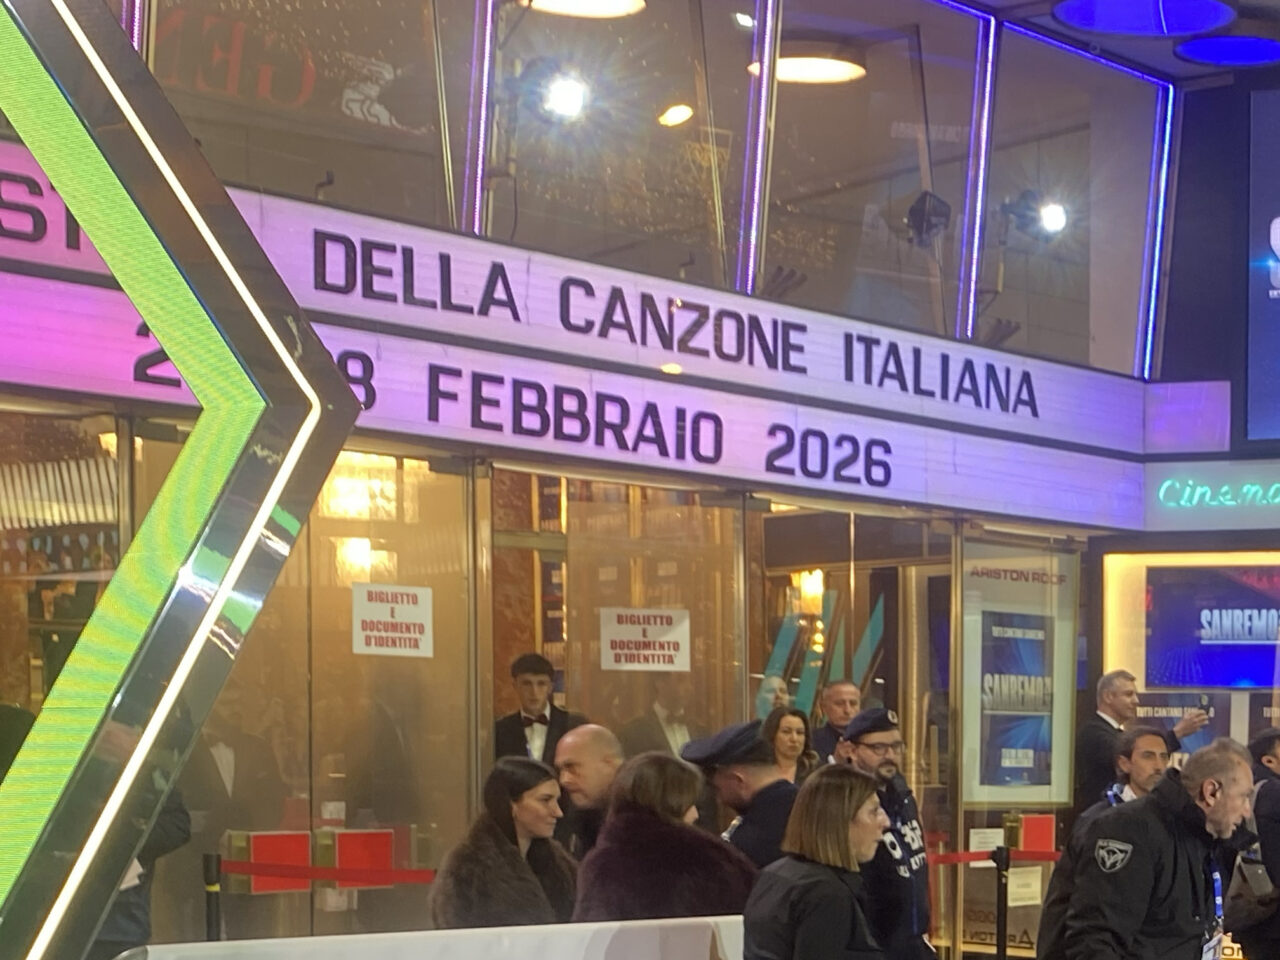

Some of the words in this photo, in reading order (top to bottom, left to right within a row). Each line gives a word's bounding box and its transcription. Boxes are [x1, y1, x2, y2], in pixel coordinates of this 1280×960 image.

[314, 228, 521, 323] DELLA
[559, 275, 808, 374] CANZONE
[844, 332, 1040, 418] ITALIANA
[427, 362, 723, 465] FEBBRAIO
[765, 422, 893, 488] 2026
[969, 566, 1030, 584] ARISTON
[1031, 570, 1068, 585] ROOF
[366, 589, 419, 605] BIGLIETTO
[361, 620, 425, 635] DOCUMENTO
[616, 613, 673, 626] BIGLIETTO
[1200, 608, 1278, 641] SANREMO
[610, 640, 680, 652] DOCUMENTO
